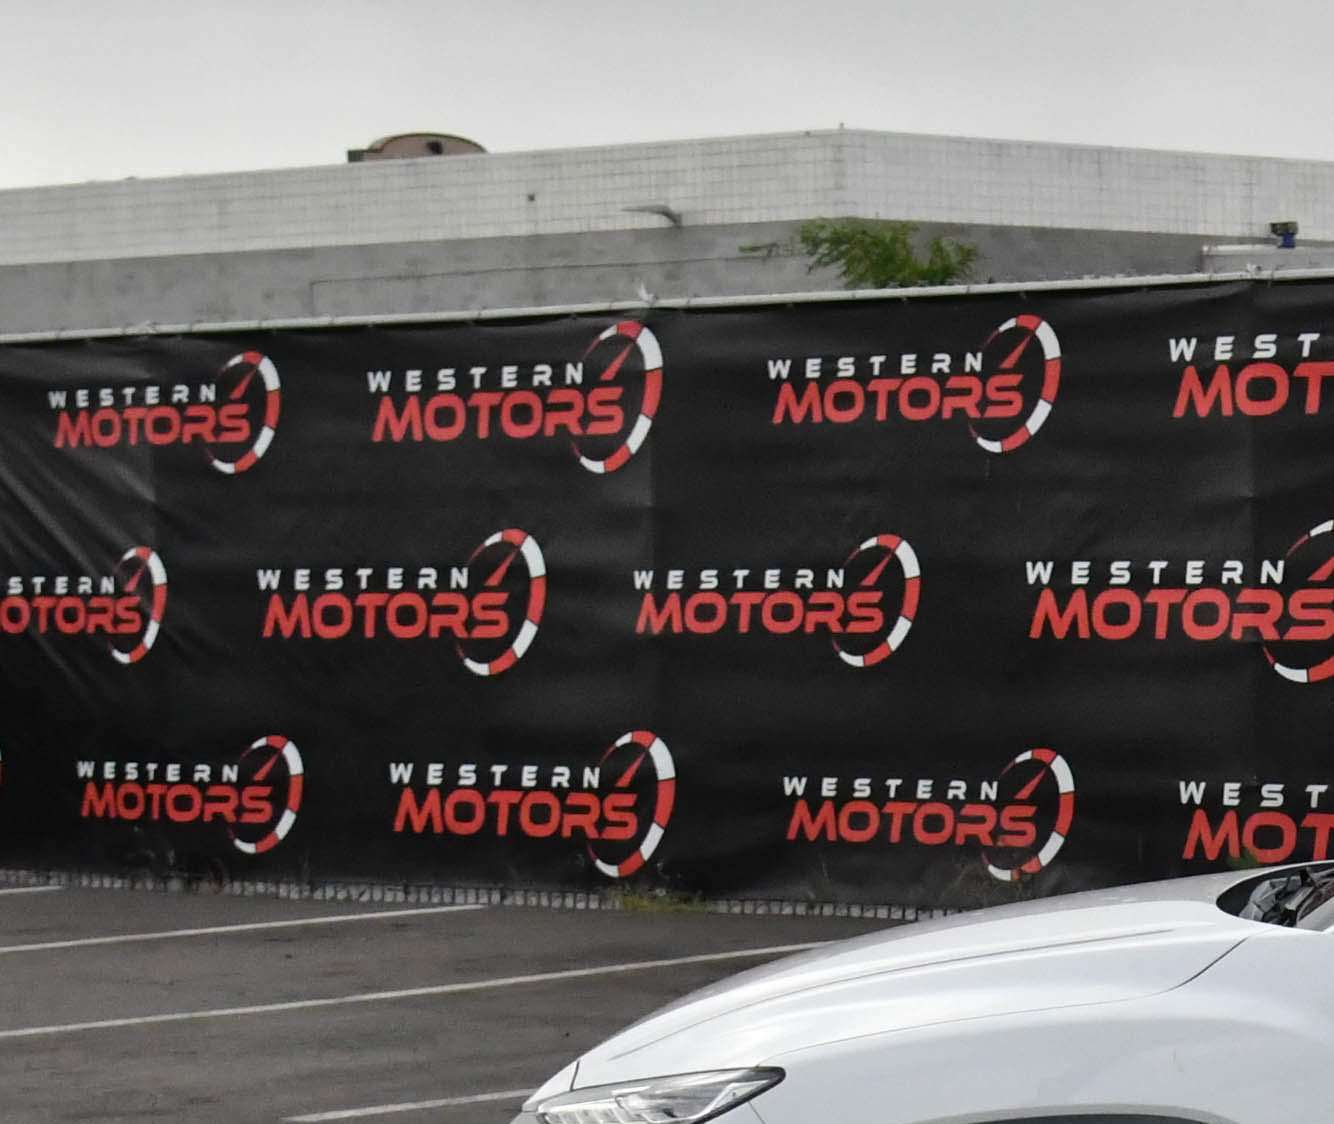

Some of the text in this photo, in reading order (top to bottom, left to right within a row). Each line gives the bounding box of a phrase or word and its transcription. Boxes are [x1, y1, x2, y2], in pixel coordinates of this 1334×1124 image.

[368, 363, 582, 392] WESTERN
[768, 353, 982, 379] WESTERN
[50, 385, 215, 407] WESTERN
[773, 373, 1024, 424] MOTORS
[56, 403, 250, 448] MOTORS
[373, 387, 624, 442] MOTORS
[258, 568, 468, 590] WESTERN
[634, 569, 843, 589] WESTERN
[1026, 560, 1284, 584] WESTERN
[264, 592, 509, 639] MOTORS
[636, 590, 884, 634] MOTORS
[78, 762, 237, 781] WESTERN
[391, 763, 600, 788] WESTERN
[82, 781, 272, 823] MOTORS
[784, 777, 997, 800] WESTERN
[394, 788, 638, 840] MOTORS
[787, 799, 1036, 847] MOTORS
